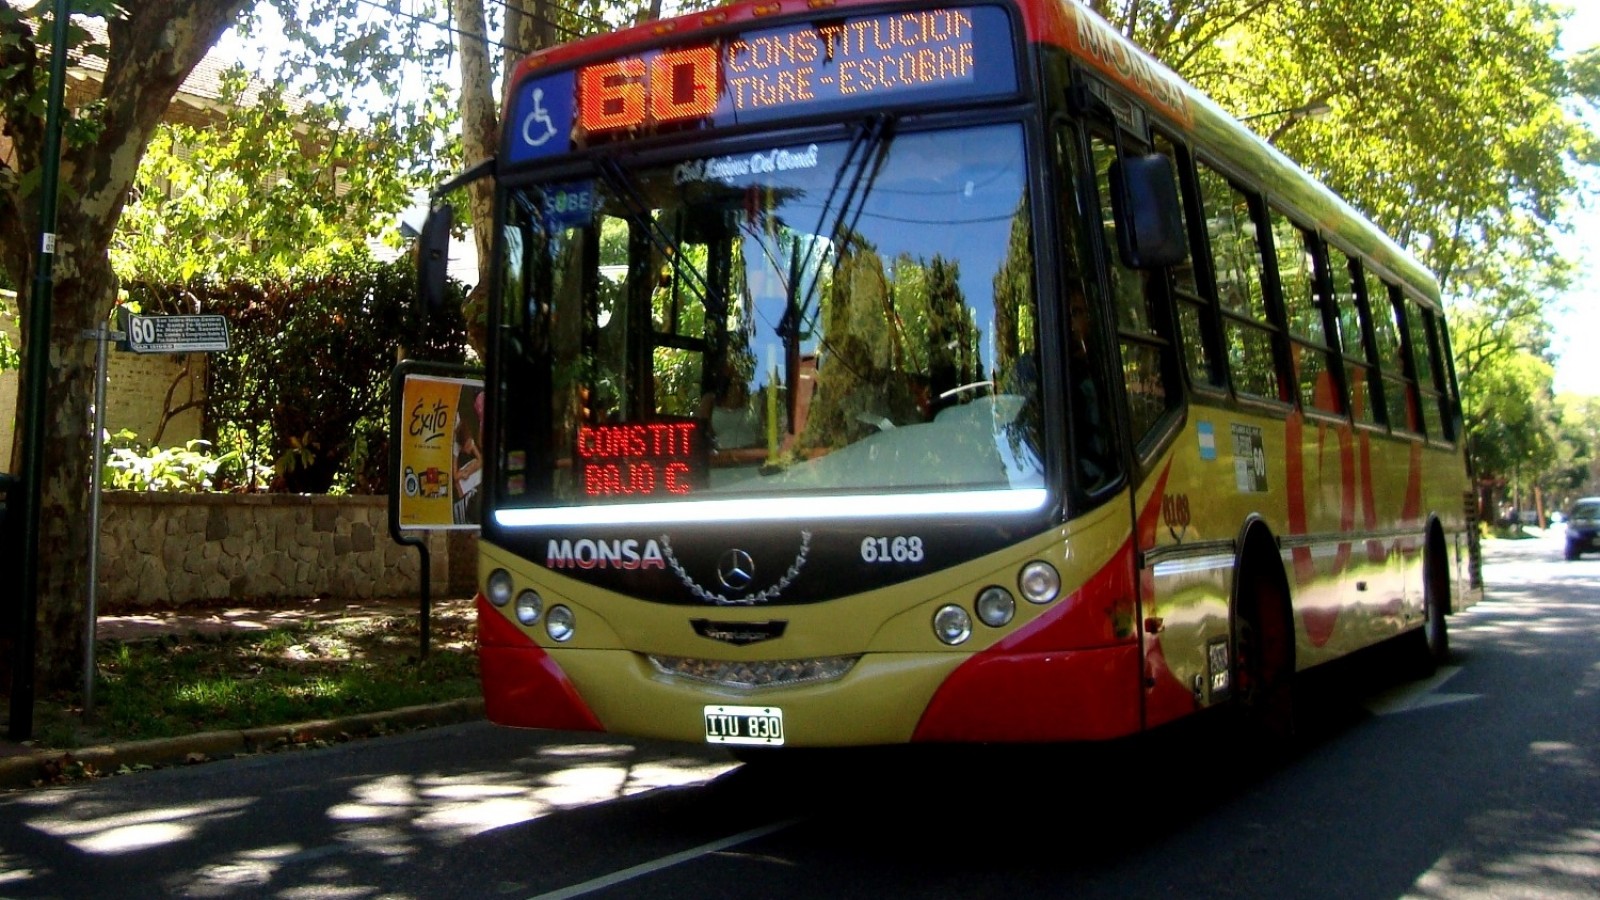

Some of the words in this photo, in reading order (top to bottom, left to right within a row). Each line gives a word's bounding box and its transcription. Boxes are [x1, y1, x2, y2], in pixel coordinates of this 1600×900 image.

[582, 46, 717, 131] 60
[131, 317, 155, 344] 60
[409, 398, 449, 437] Éxito
[579, 422, 696, 457] CONSTIT
[664, 462, 690, 495] C
[546, 538, 667, 570] MONSA
[860, 535, 924, 562] 6163
[707, 714, 740, 737] ITU
[747, 715, 780, 739] 830
